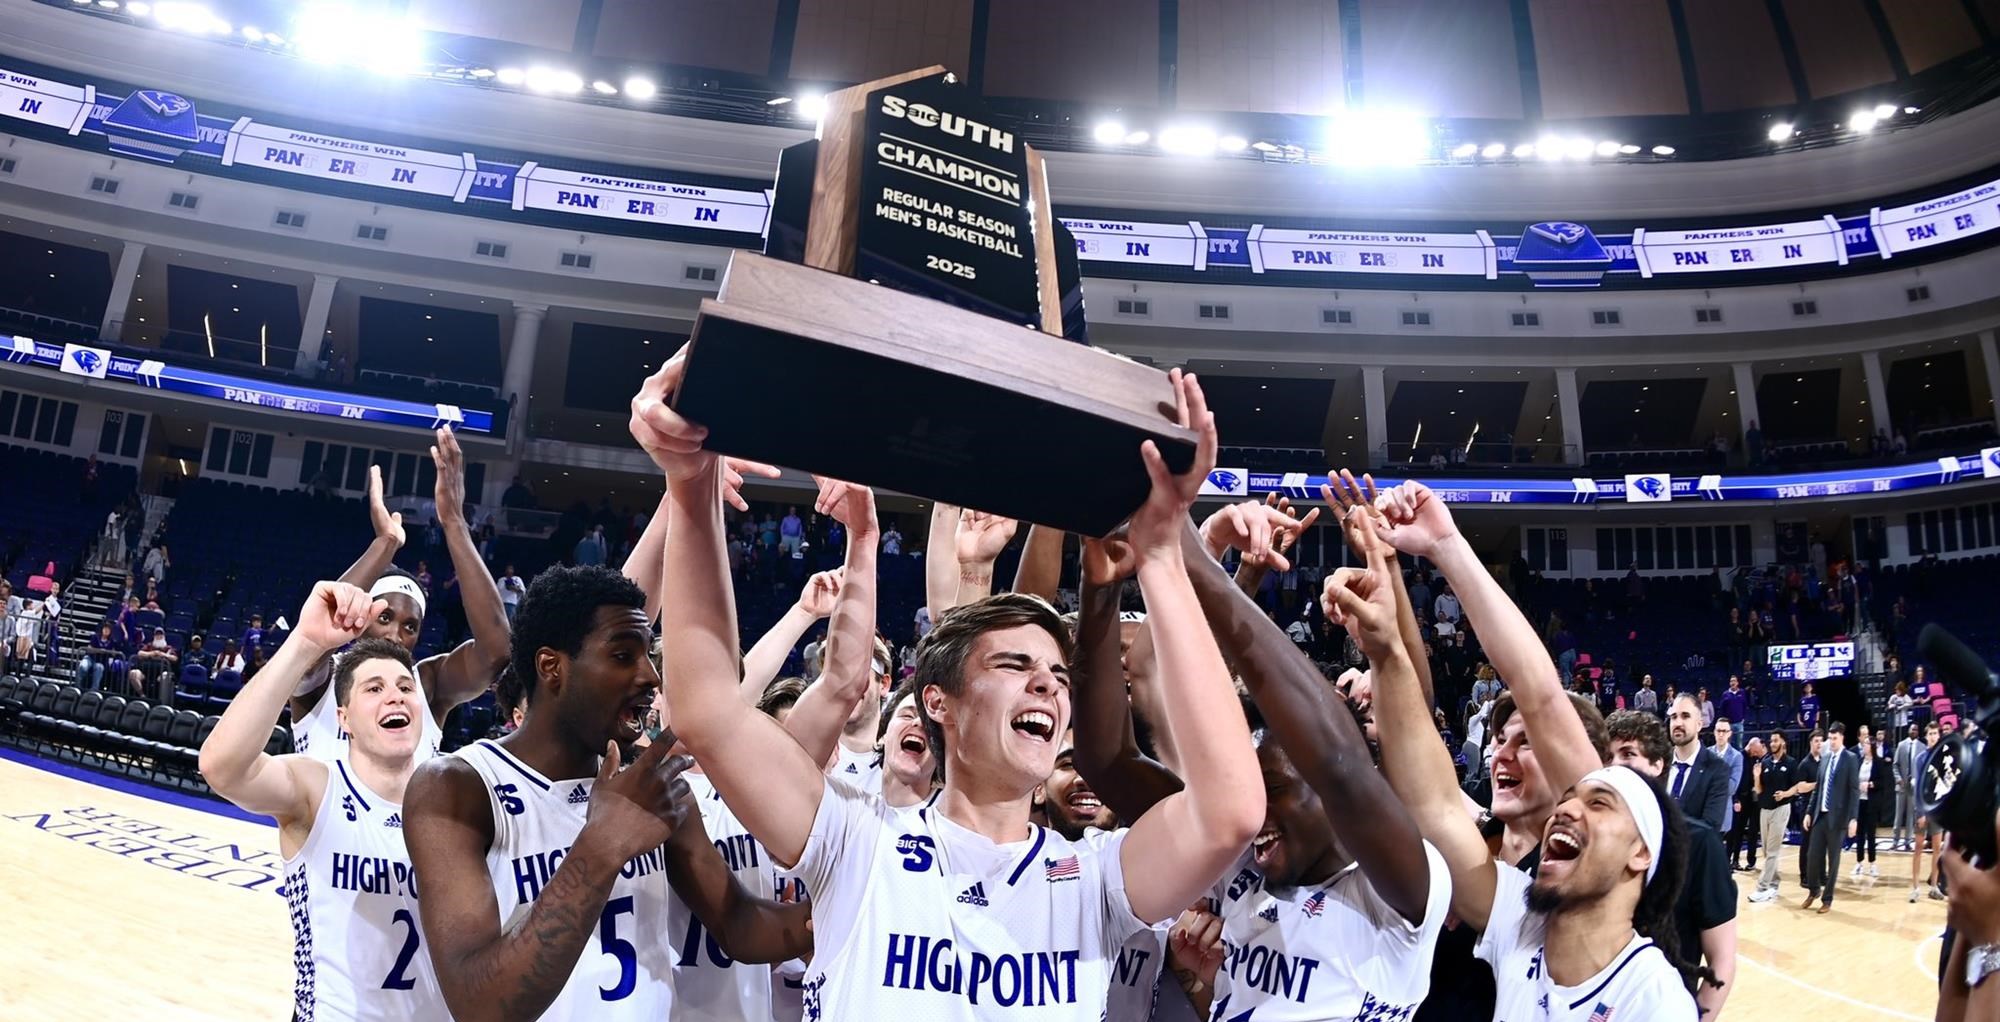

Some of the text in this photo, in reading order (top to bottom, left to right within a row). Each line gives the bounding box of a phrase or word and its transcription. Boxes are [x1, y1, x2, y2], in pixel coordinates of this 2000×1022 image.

[10, 75, 37, 87] WIN
[19, 98, 42, 114] IN
[908, 106, 940, 123] BIG
[881, 95, 1013, 153] SOUTH
[289, 133, 406, 157] PANTHERS WIN
[391, 168, 417, 184] IN
[877, 142, 1020, 200] CHAMPION
[580, 176, 707, 196] PANTHERS WIN
[694, 207, 720, 222] IN
[883, 187, 1016, 238] REGULAR SEASON
[876, 203, 1023, 258] MEN'S BASKETBALL
[1099, 223, 1134, 231] WIN
[1684, 228, 1785, 240] PANTHERS WIN
[1308, 233, 1427, 243] PANTHERS WIN
[1126, 242, 1150, 256] IN
[1783, 244, 1803, 259] IN
[926, 255, 976, 279] 2025
[1422, 254, 1444, 267] IN
[105, 411, 122, 423] 103
[340, 406, 365, 420] IN
[234, 432, 252, 445] 102
[1873, 480, 1890, 491] IN
[1491, 491, 1511, 502] IN
[896, 839, 917, 850] BIG
[2, 813, 288, 897] UBEIN
[331, 852, 391, 894] HIGH
[956, 894, 989, 907] adidas
[381, 909, 420, 990] 2
[599, 895, 637, 1002] 5
[968, 950, 1080, 1007] POINT
[1230, 943, 1319, 1003] POINT
